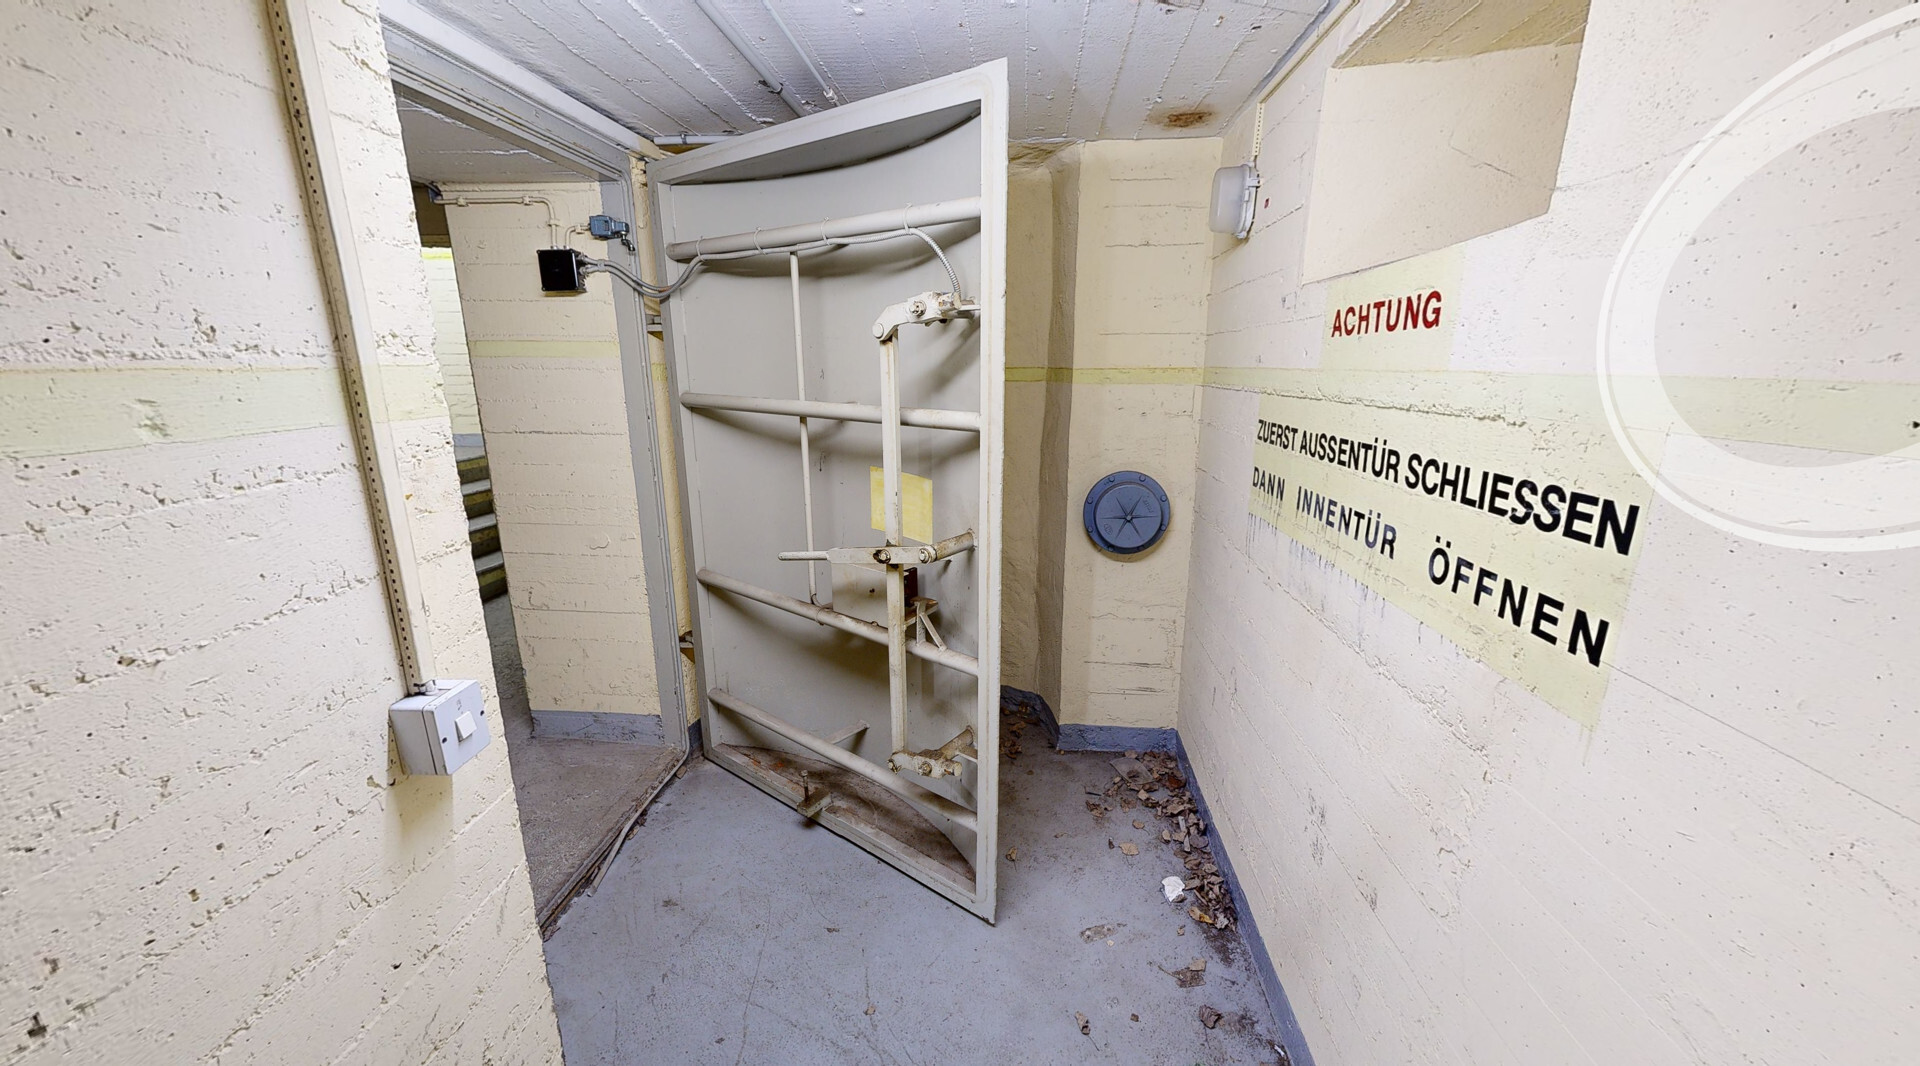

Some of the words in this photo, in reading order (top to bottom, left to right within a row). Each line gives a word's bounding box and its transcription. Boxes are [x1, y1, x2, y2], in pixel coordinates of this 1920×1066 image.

[1332, 290, 1442, 338] ACHTUNG
[1257, 419, 1298, 451] ZUERST
[1300, 430, 1400, 483] AUSSENTÜR
[1405, 453, 1640, 556] SCHLIESSEN
[1252, 467, 1285, 501] DANN
[1296, 486, 1397, 559] INNENTÜR
[1428, 535, 1610, 667] ÖFFNEN
